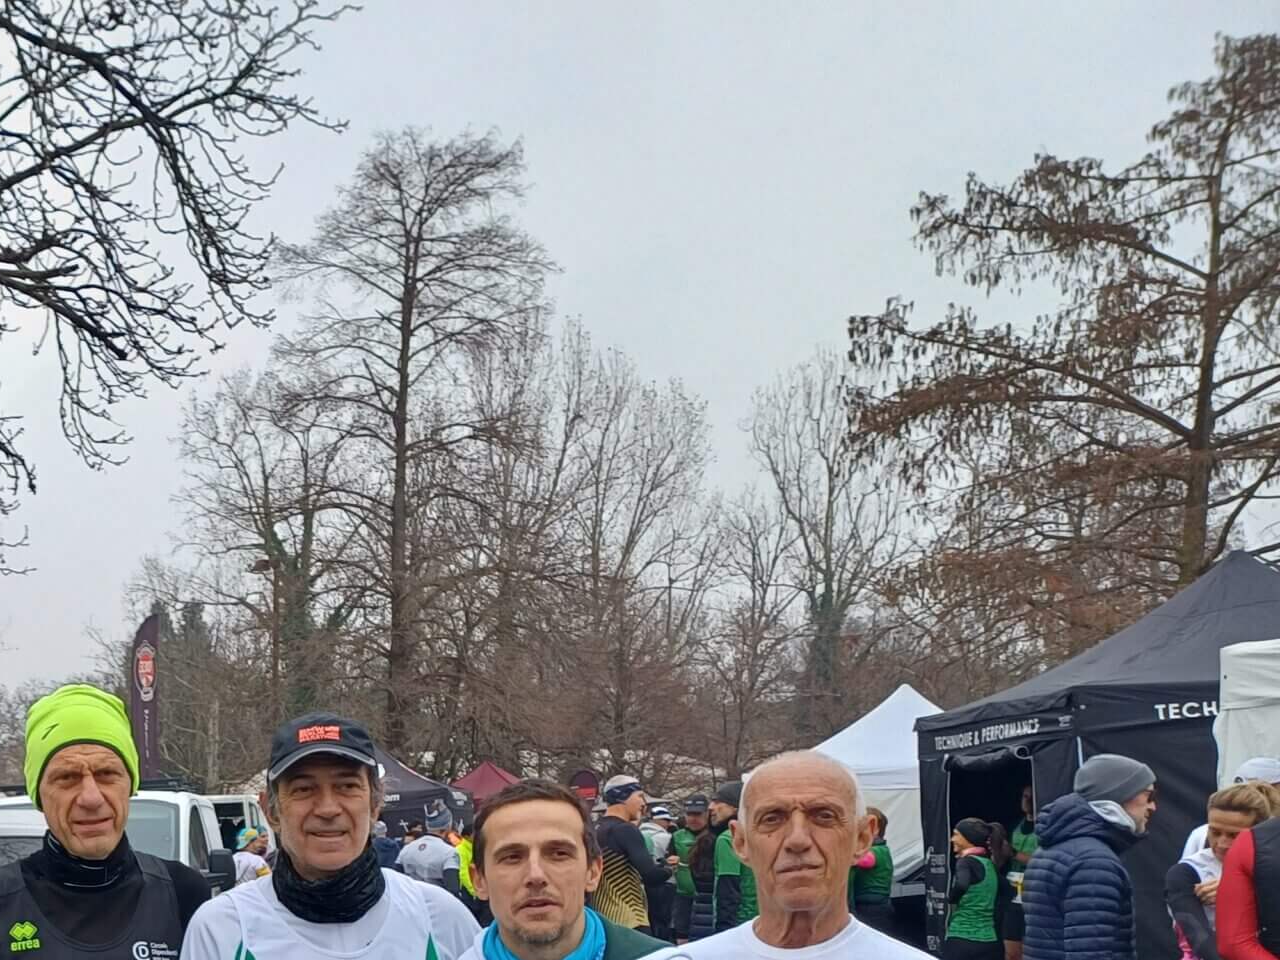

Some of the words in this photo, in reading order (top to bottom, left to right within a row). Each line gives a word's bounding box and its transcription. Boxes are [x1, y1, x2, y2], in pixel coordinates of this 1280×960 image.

[1154, 701, 1218, 720] TECH
[934, 731, 973, 750] TECHNIQUE
[981, 718, 1041, 743] PERFORMANCE
